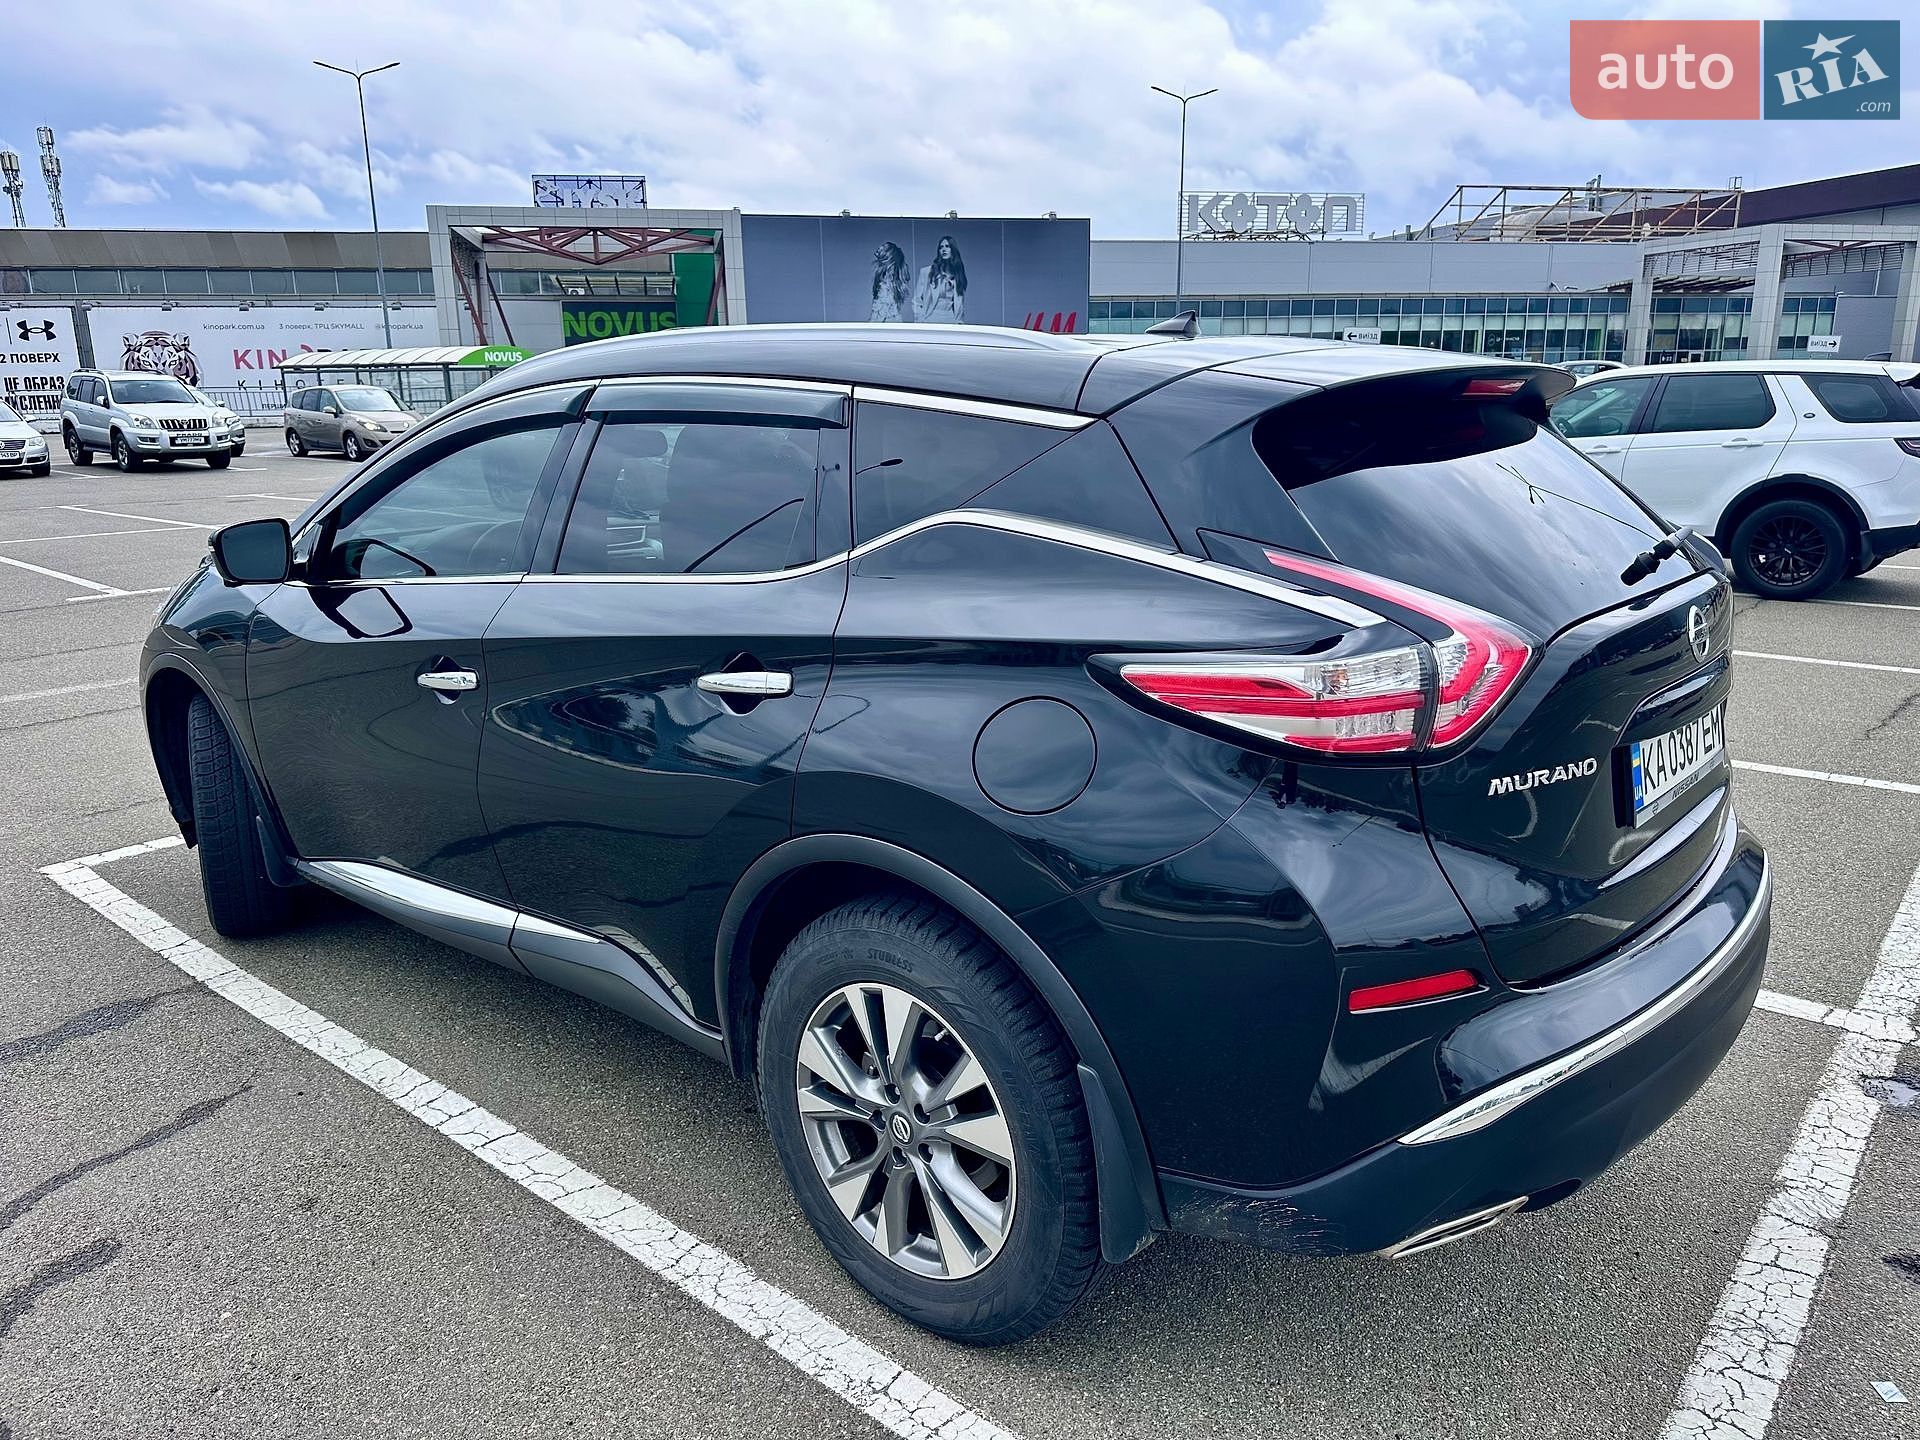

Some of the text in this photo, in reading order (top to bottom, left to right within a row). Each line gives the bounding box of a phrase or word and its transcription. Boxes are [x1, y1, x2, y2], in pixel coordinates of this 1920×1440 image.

[203, 323, 265, 331] kinopark.com.ua
[375, 323, 424, 332] @knopark.ua
[563, 311, 676, 338] NOVUS
[0, 353, 61, 364] 2 ПОВЕРХ
[485, 351, 523, 362] NOVUS
[23, 376, 65, 391] ОБРАЗ
[1642, 705, 1721, 795] KA 0387 EM
[1488, 757, 1598, 796] MURANO
[1634, 784, 1643, 801] UA
[867, 948, 914, 973] STUDLESS
